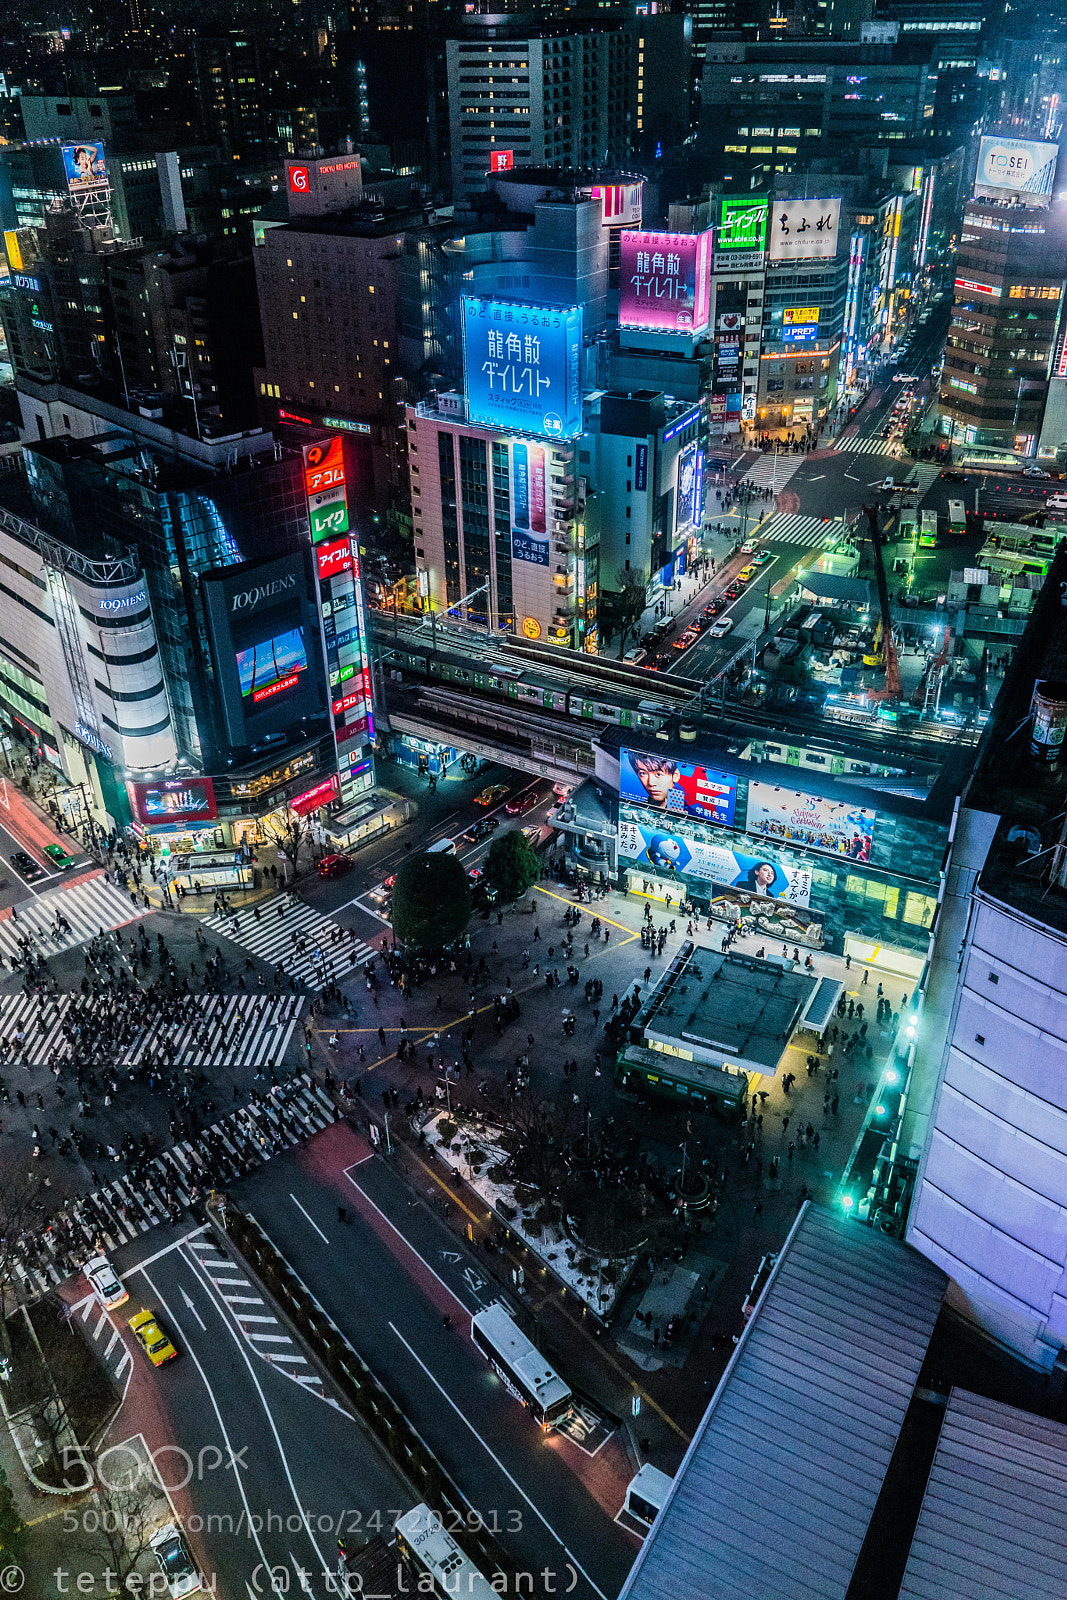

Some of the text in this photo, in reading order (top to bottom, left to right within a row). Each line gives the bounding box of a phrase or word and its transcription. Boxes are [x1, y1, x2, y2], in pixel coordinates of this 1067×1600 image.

[319, 161, 359, 174] TOKYU REI HOTEL
[990, 154, 1028, 169] TOSEI
[722, 205, 768, 229] エイブル
[779, 213, 833, 235] ちふれ
[623, 234, 697, 247] のど、直接、うるおう
[717, 235, 765, 244] www.able.co.jp
[636, 251, 681, 276] 龍角散
[630, 275, 688, 300] ダイレクト
[468, 306, 561, 329] のど、直接、うるおう
[792, 327, 815, 336] PREP
[487, 329, 541, 365] 龍角散
[481, 361, 551, 398] ダイレクト
[488, 393, 517, 406] スティック
[311, 468, 344, 488] アコム
[315, 509, 345, 532] レイク
[319, 547, 350, 567] アイフル
[514, 539, 549, 555] のど、直接、
[518, 550, 544, 563] うるおう
[340, 667, 354, 678] レイク
[336, 696, 357, 711] アコム
[695, 806, 728, 822] 学割先生
[620, 824, 630, 853] 強みだ。
[630, 826, 638, 850] キミの
[788, 870, 800, 902] すべてが、
[800, 872, 810, 897] キミの
[414, 1522, 440, 1546] 30729
